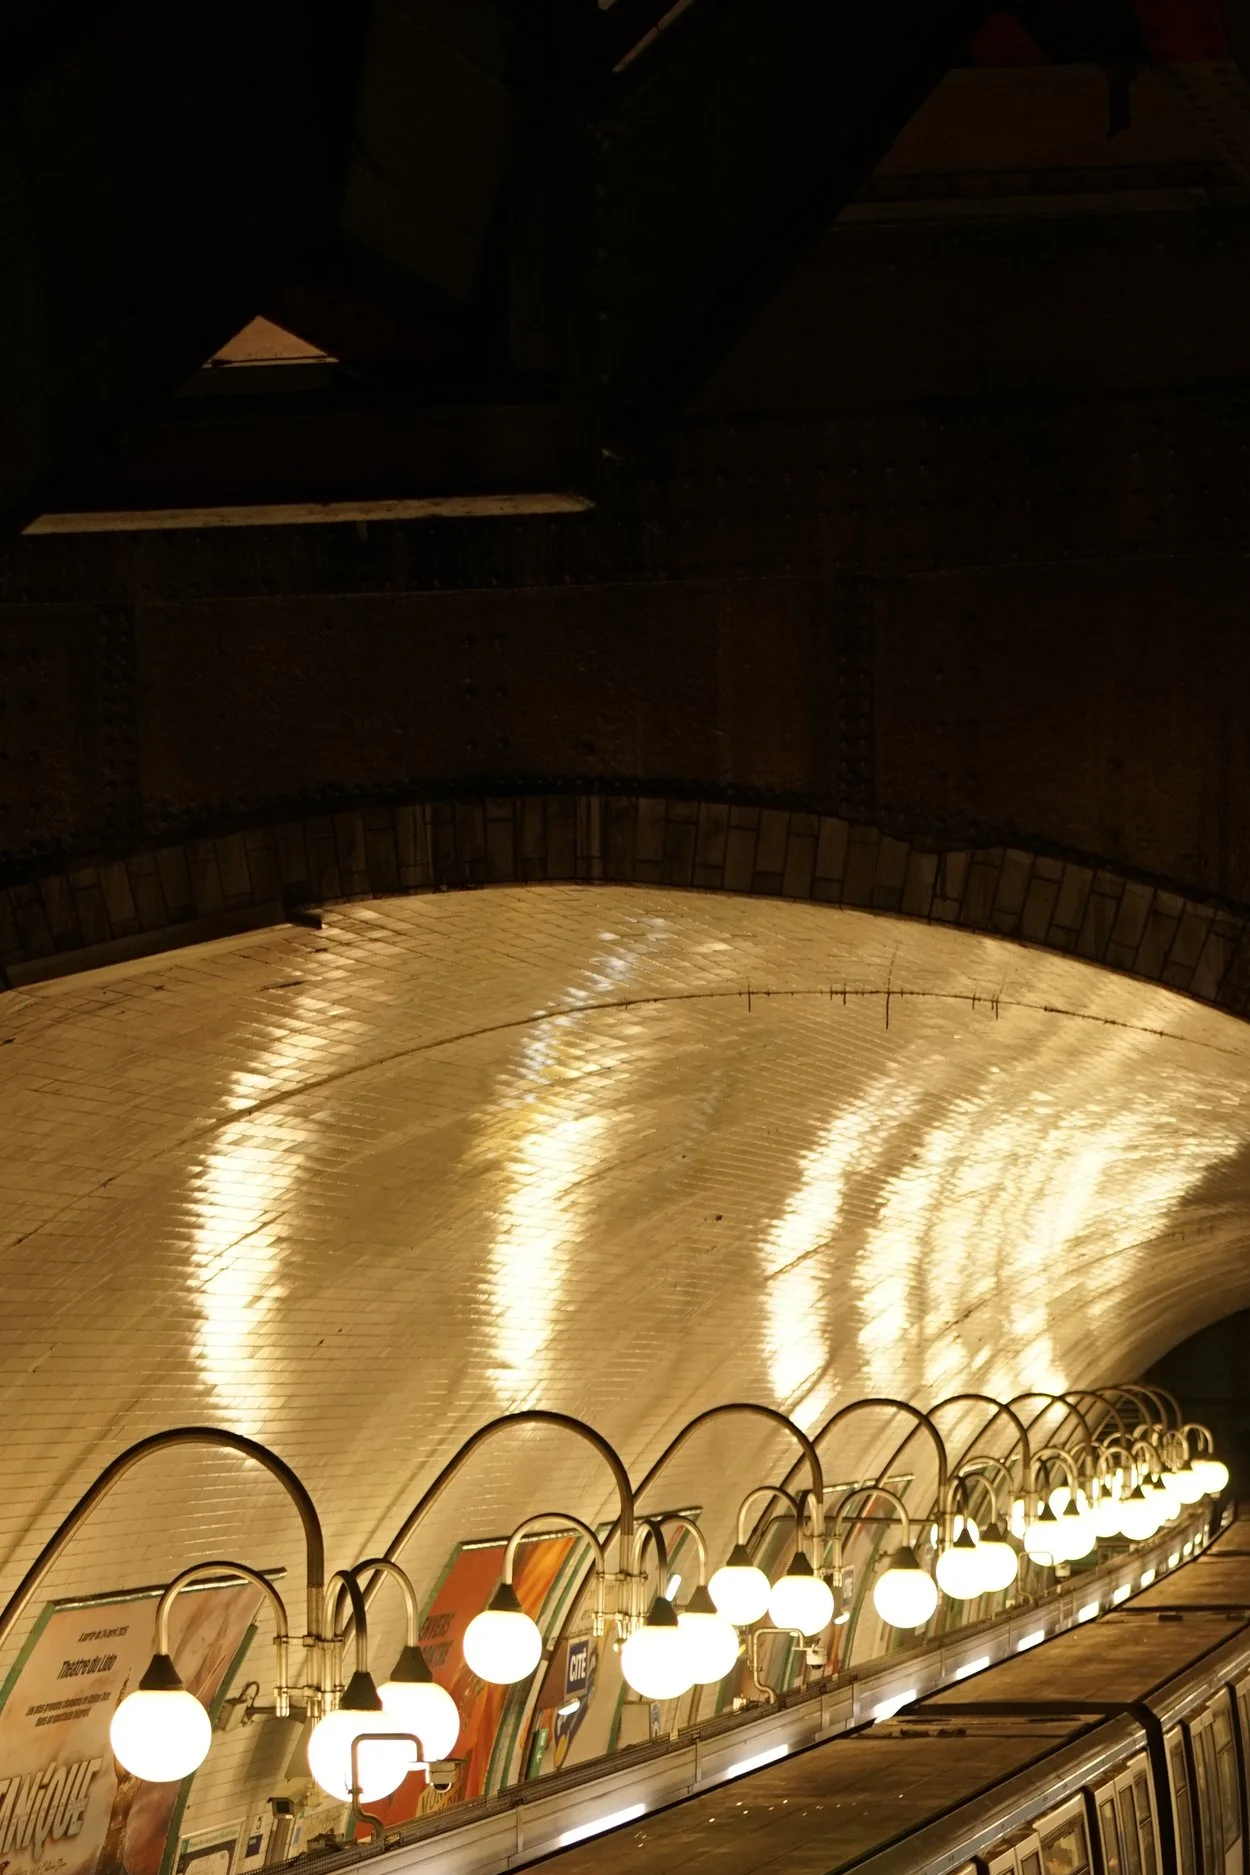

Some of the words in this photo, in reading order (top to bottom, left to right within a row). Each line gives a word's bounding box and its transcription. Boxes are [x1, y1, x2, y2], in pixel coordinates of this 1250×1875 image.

[86, 1655, 102, 1675] du
[96, 1653, 117, 1673] Lido
[569, 1647, 587, 1682] CITÉ
